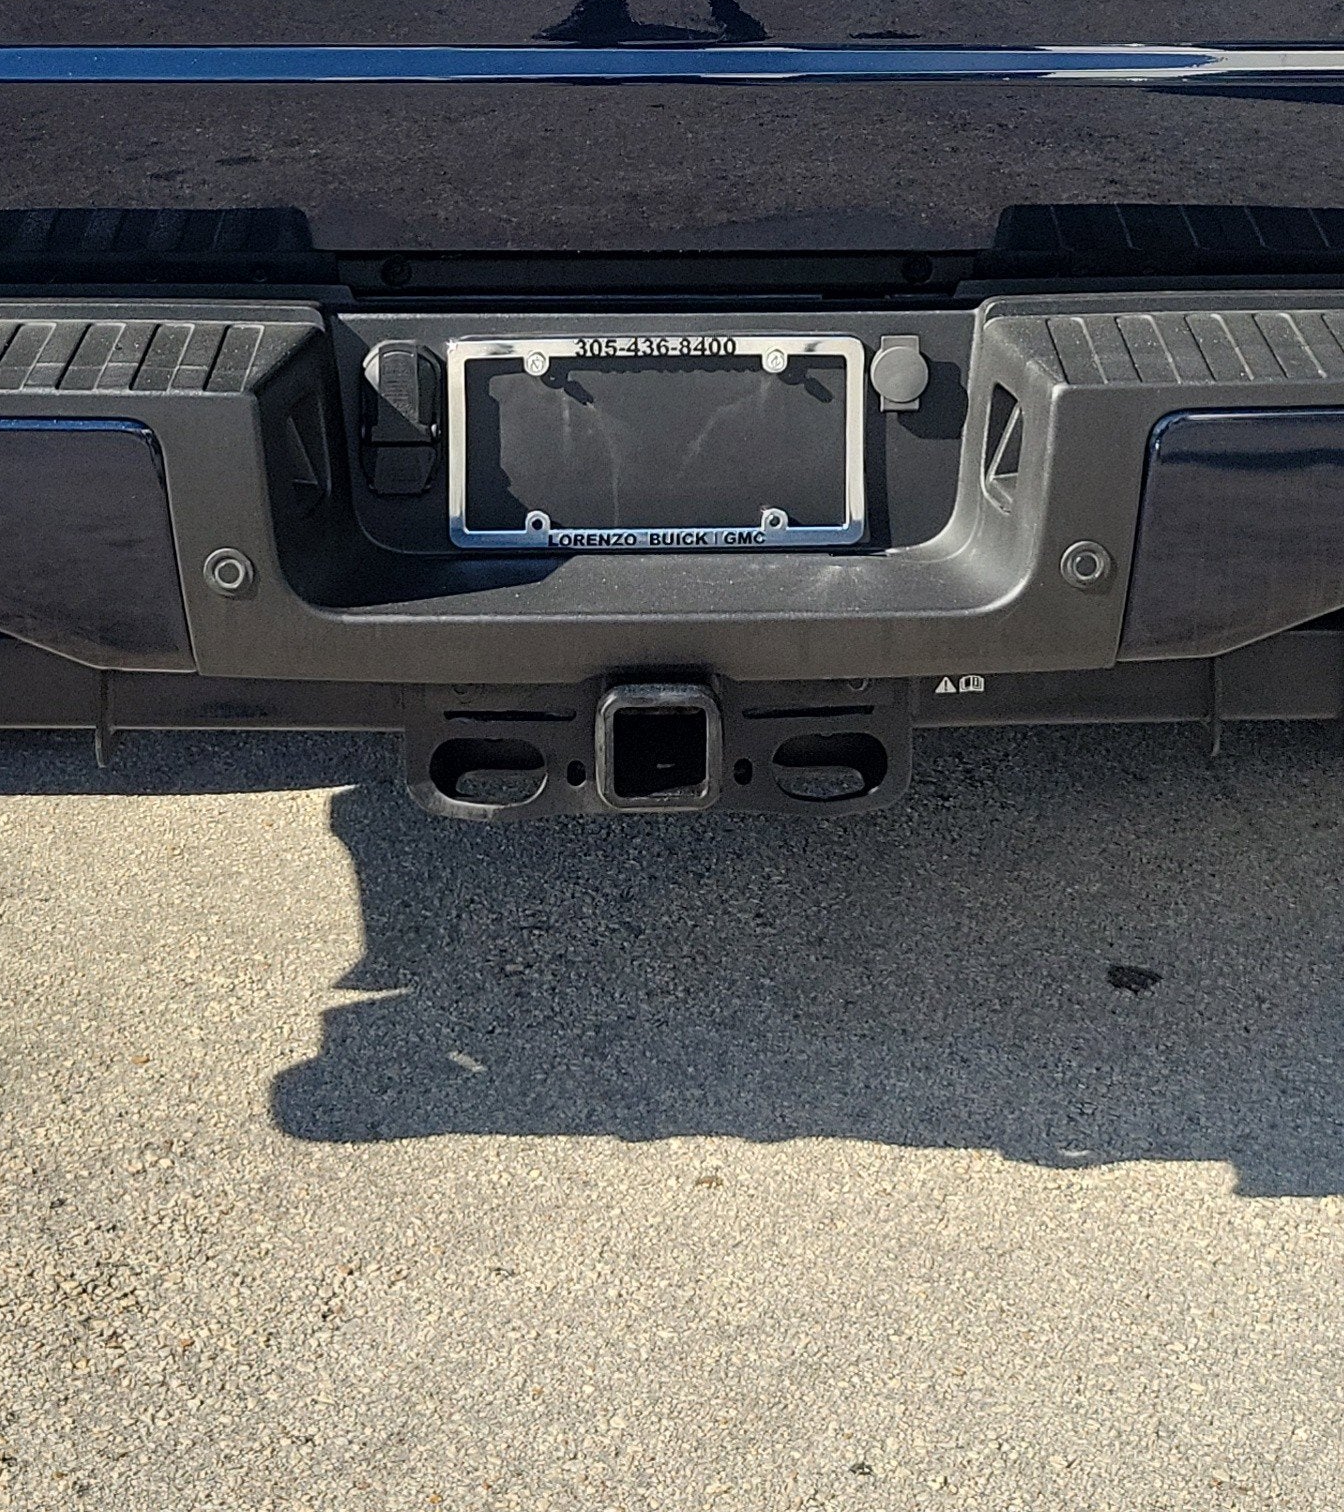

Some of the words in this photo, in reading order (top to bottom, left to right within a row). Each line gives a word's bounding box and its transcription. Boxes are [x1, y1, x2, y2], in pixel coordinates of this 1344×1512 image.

[574, 337, 737, 358] 305-436-8400
[547, 532, 637, 547] LORENZO
[649, 531, 709, 546] BUICK
[723, 530, 766, 545] GMC
